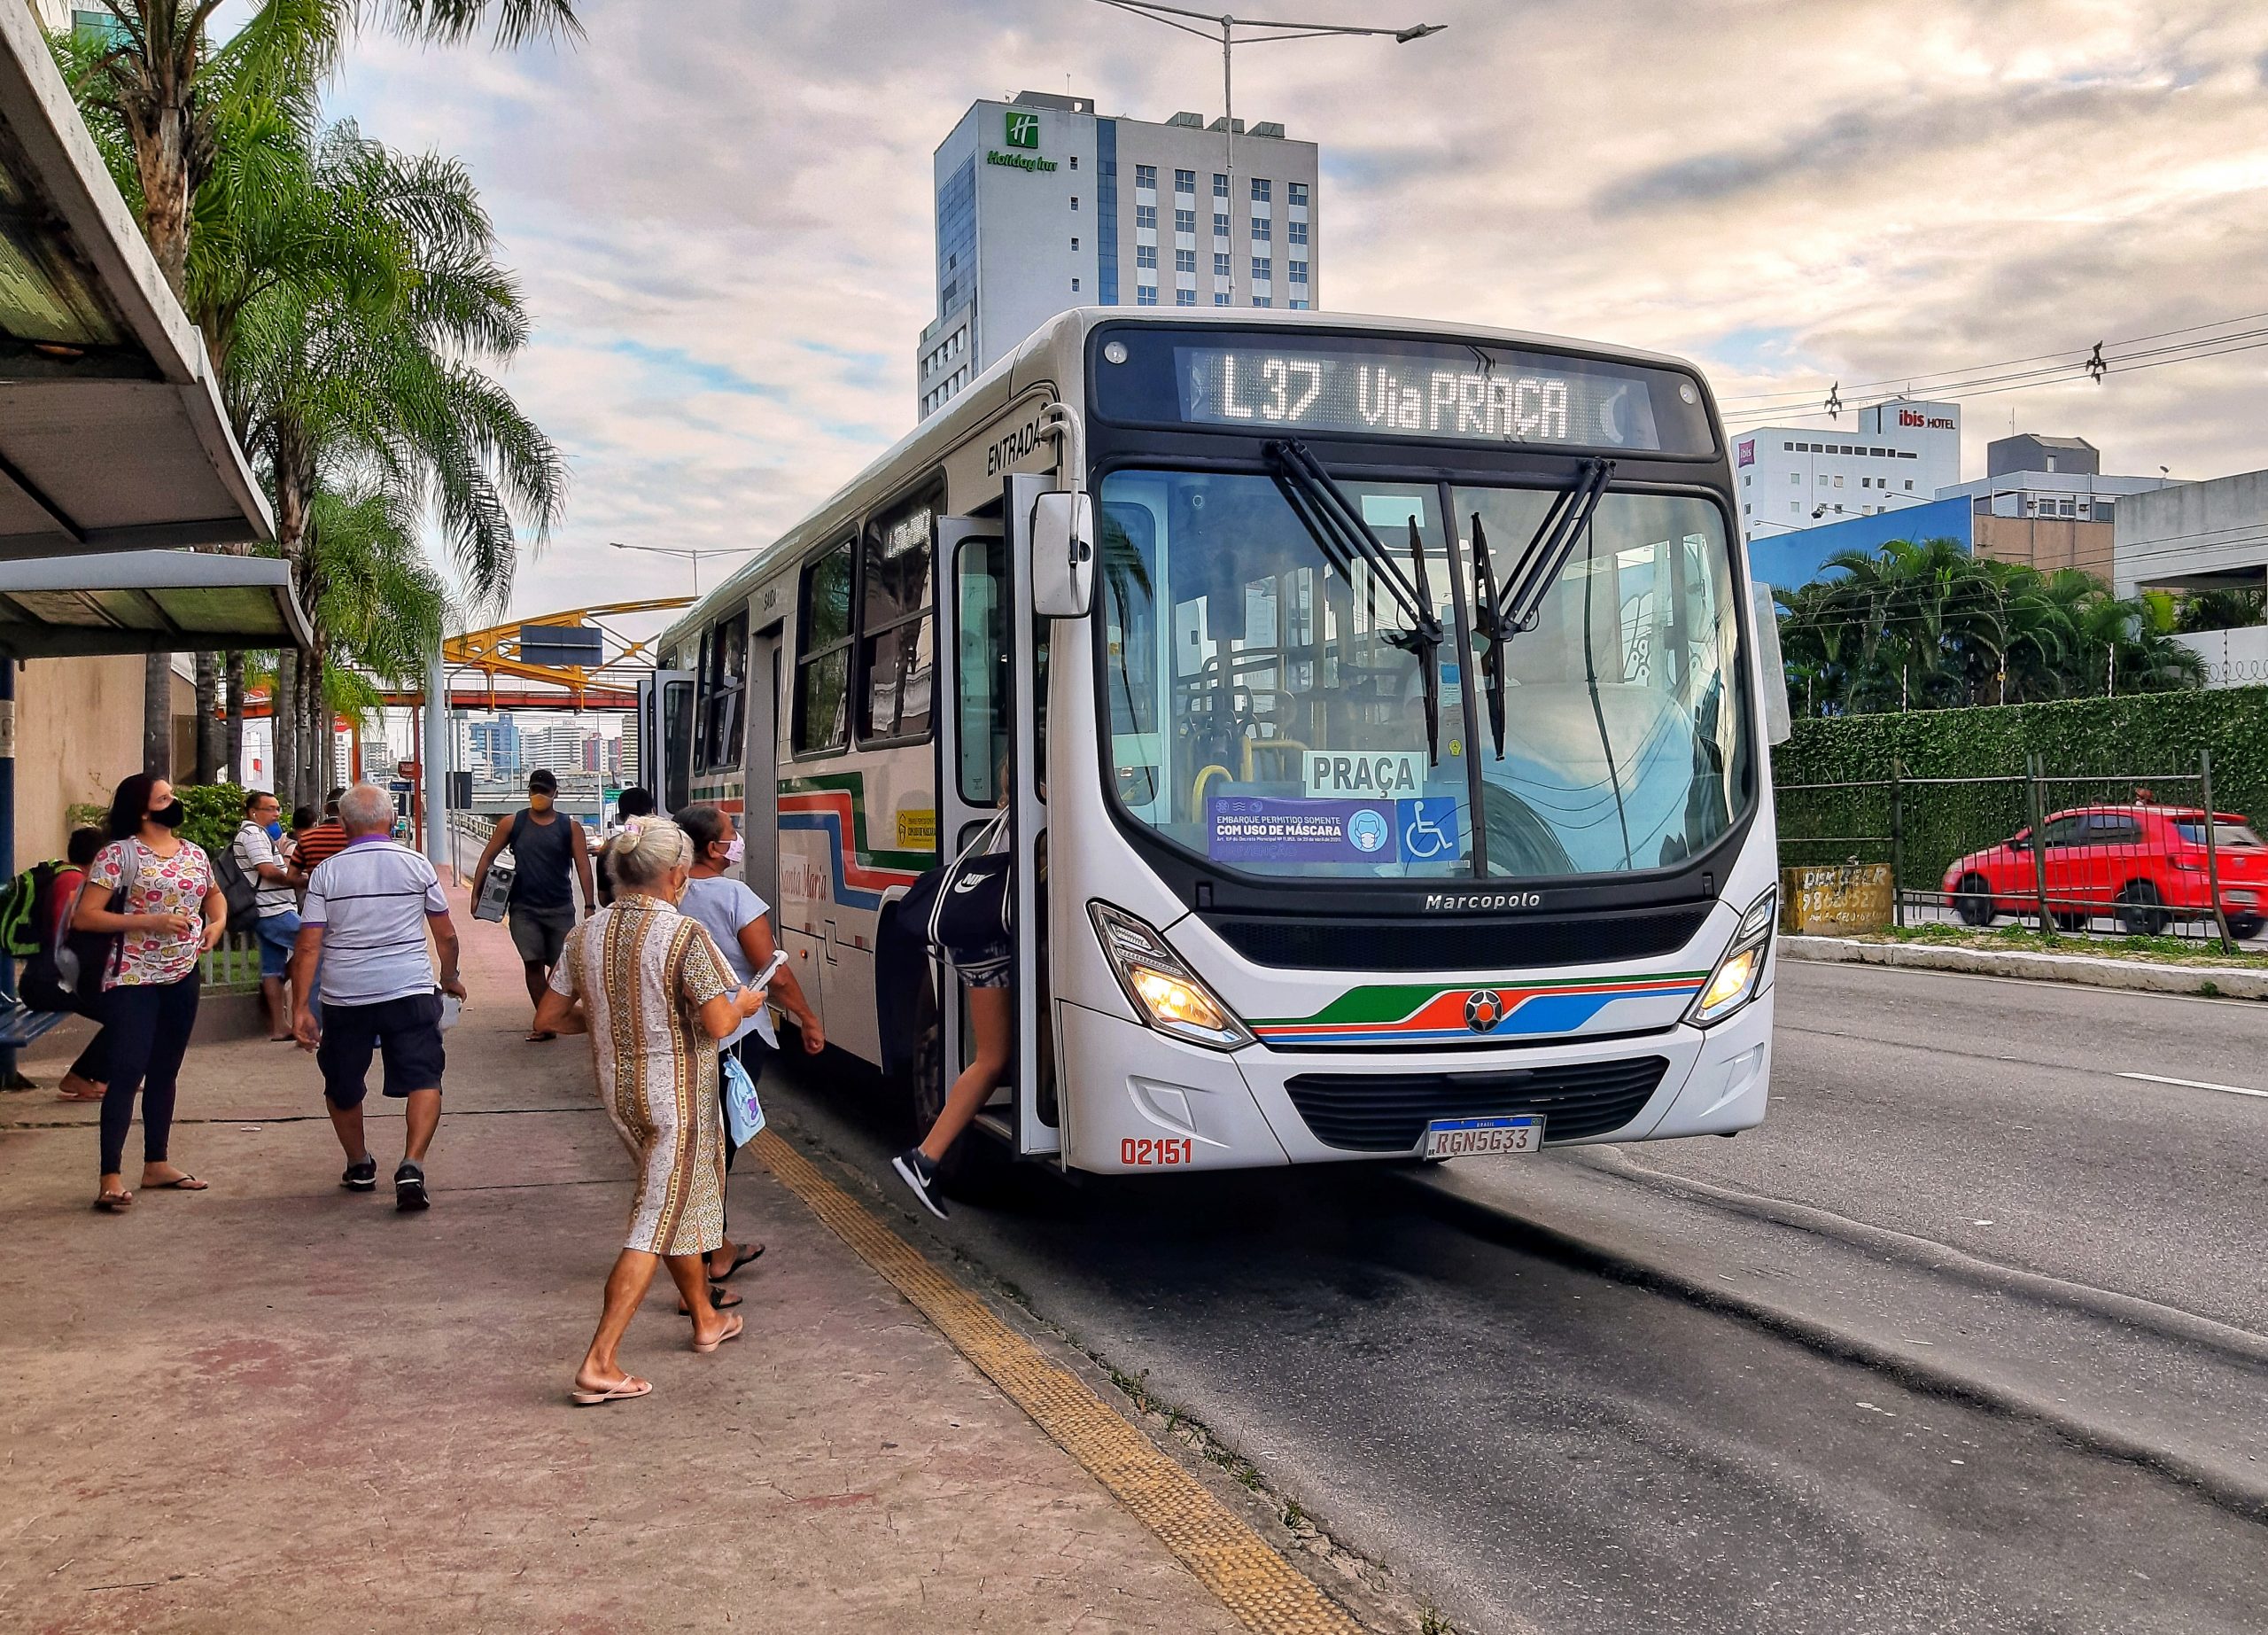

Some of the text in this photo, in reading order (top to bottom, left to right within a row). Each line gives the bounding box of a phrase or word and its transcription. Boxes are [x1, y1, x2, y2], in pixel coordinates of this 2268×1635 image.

[987, 151, 1058, 172] Holiday Inn
[1224, 354, 1567, 439] L 37 Via PRAÇA
[1899, 409, 1956, 430] ibis HOTEL
[987, 416, 1041, 477] ENTRADA
[1740, 446, 1751, 459] ibis
[1314, 757, 1416, 799] PRAÇA
[1216, 815, 1261, 824] EMBARQUE
[1261, 815, 1303, 824] PERMITIDO
[1216, 822, 1342, 837] COM USO DE MÁSCARA
[802, 864, 827, 901] Maria
[1425, 891, 1541, 911] Marcopolo
[1121, 1138, 1192, 1165] 02151
[1435, 1128, 1529, 1154] RGN5G33
